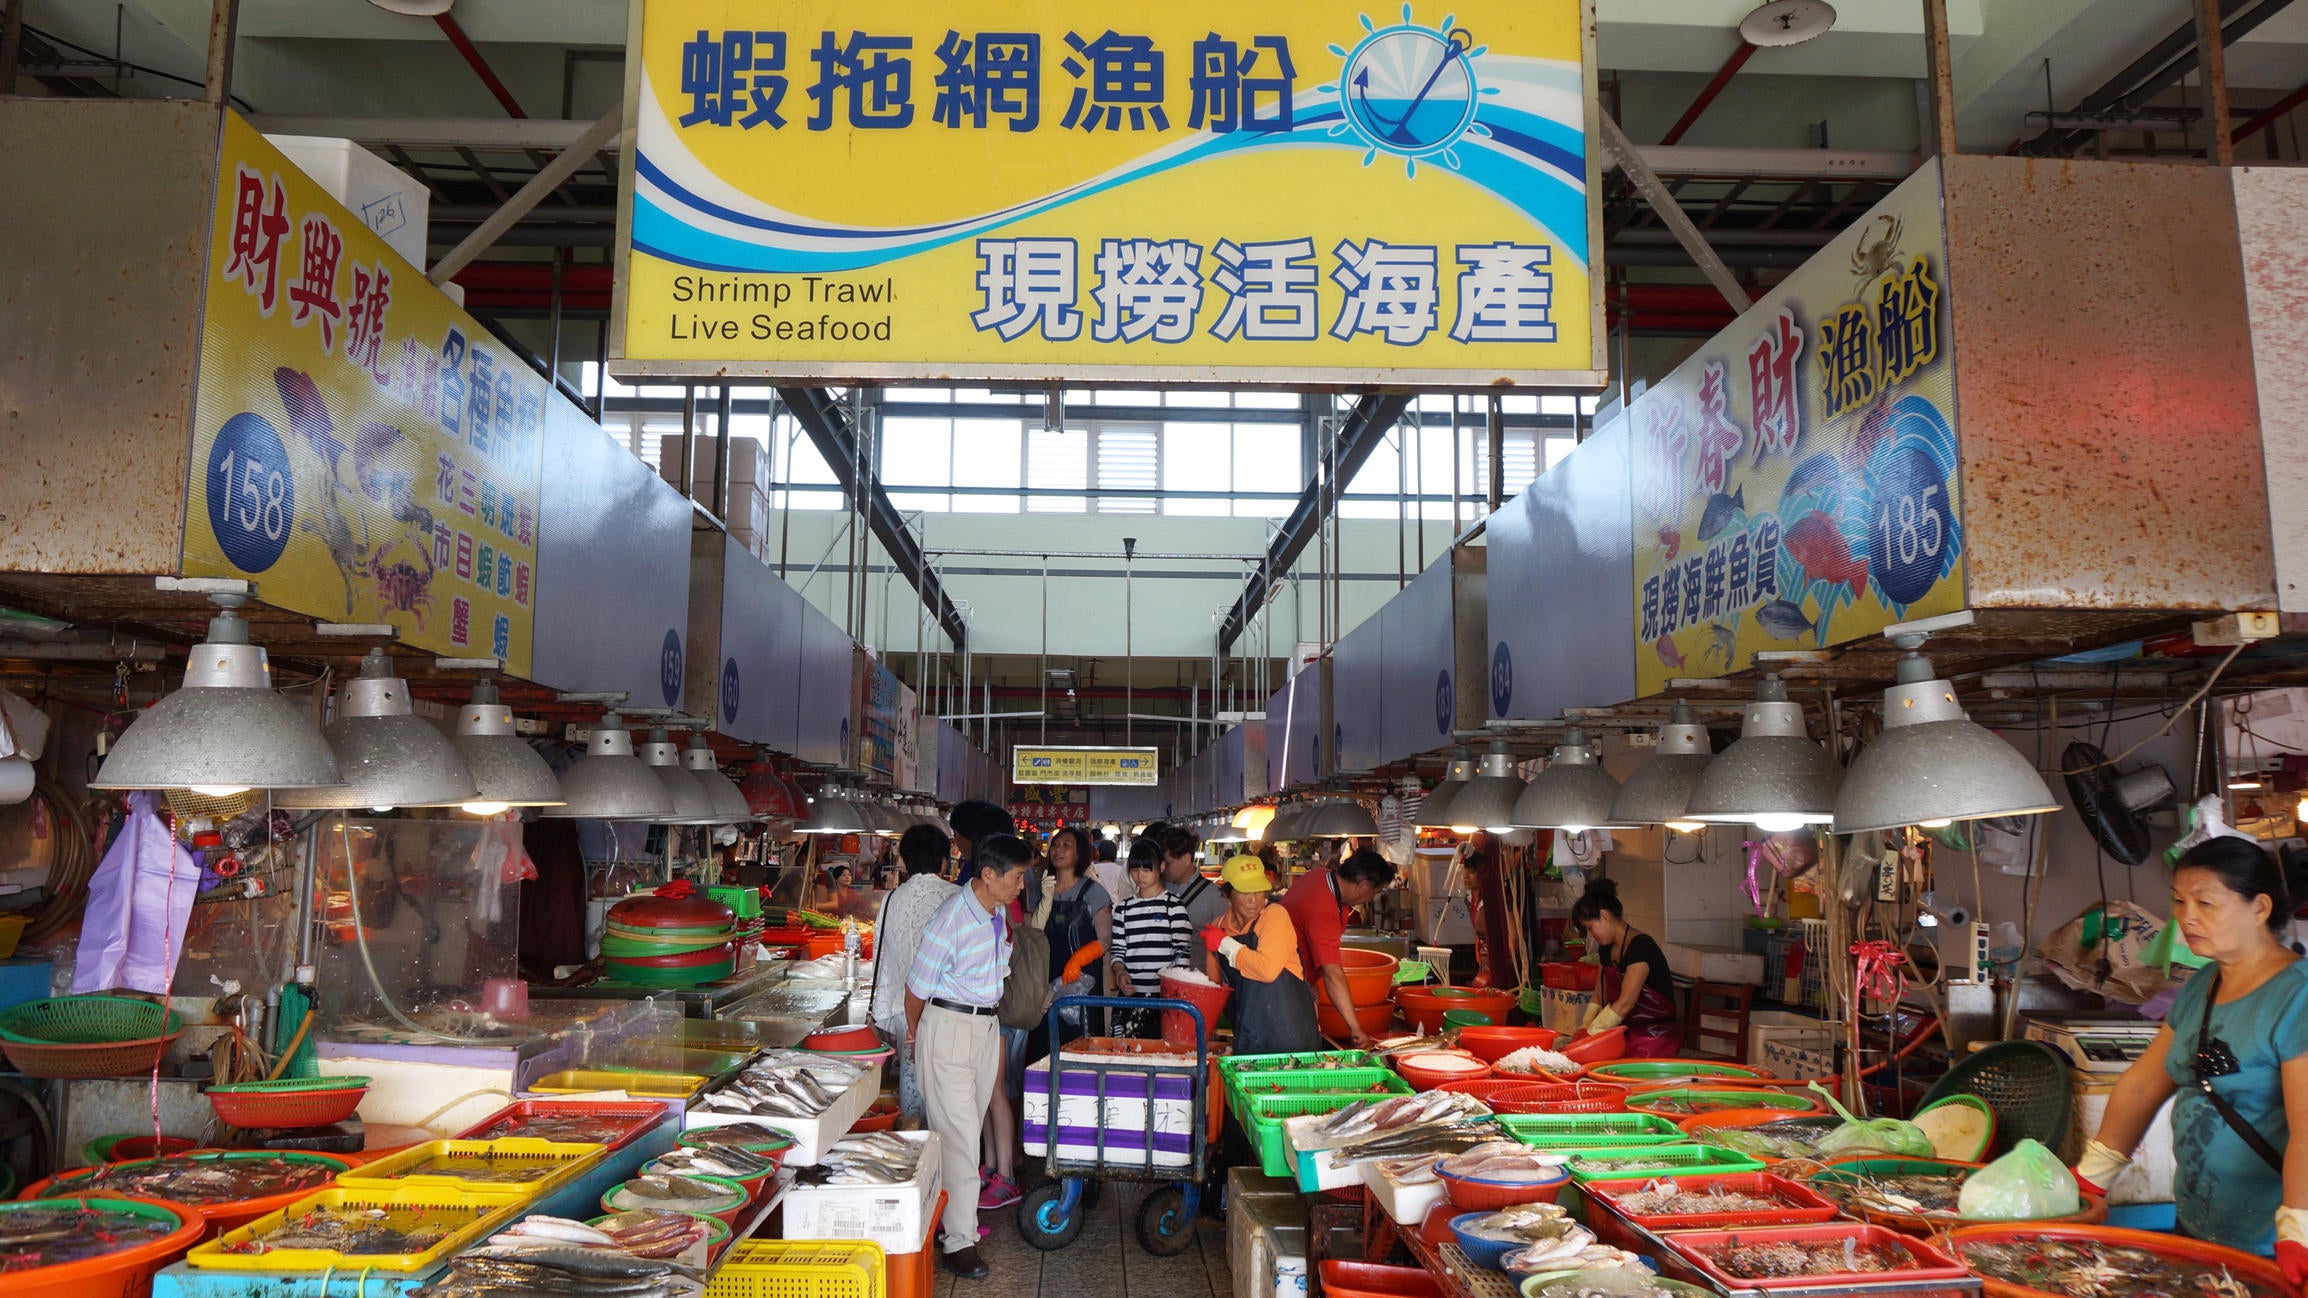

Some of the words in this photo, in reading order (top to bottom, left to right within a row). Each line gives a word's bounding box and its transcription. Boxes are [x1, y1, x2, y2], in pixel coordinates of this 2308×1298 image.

[680, 30, 1296, 133] 蝦拖網漁船
[226, 167, 393, 387] 財興號
[672, 276, 791, 308] Shrimp
[802, 277, 892, 303] Trawl
[971, 237, 1558, 345] 現撈活海產
[671, 313, 740, 340] Live
[750, 314, 892, 341] Seafood
[220, 449, 285, 541] 158
[432, 453, 455, 570] 花市
[475, 480, 497, 591] 明蝦
[1880, 484, 1942, 570] 185
[492, 490, 514, 659] 斑節蝦
[1640, 520, 1781, 643] 現撈海鮮魚貨
[662, 649, 681, 686] 159
[723, 676, 739, 708] 160
[1494, 659, 1511, 699] 184
